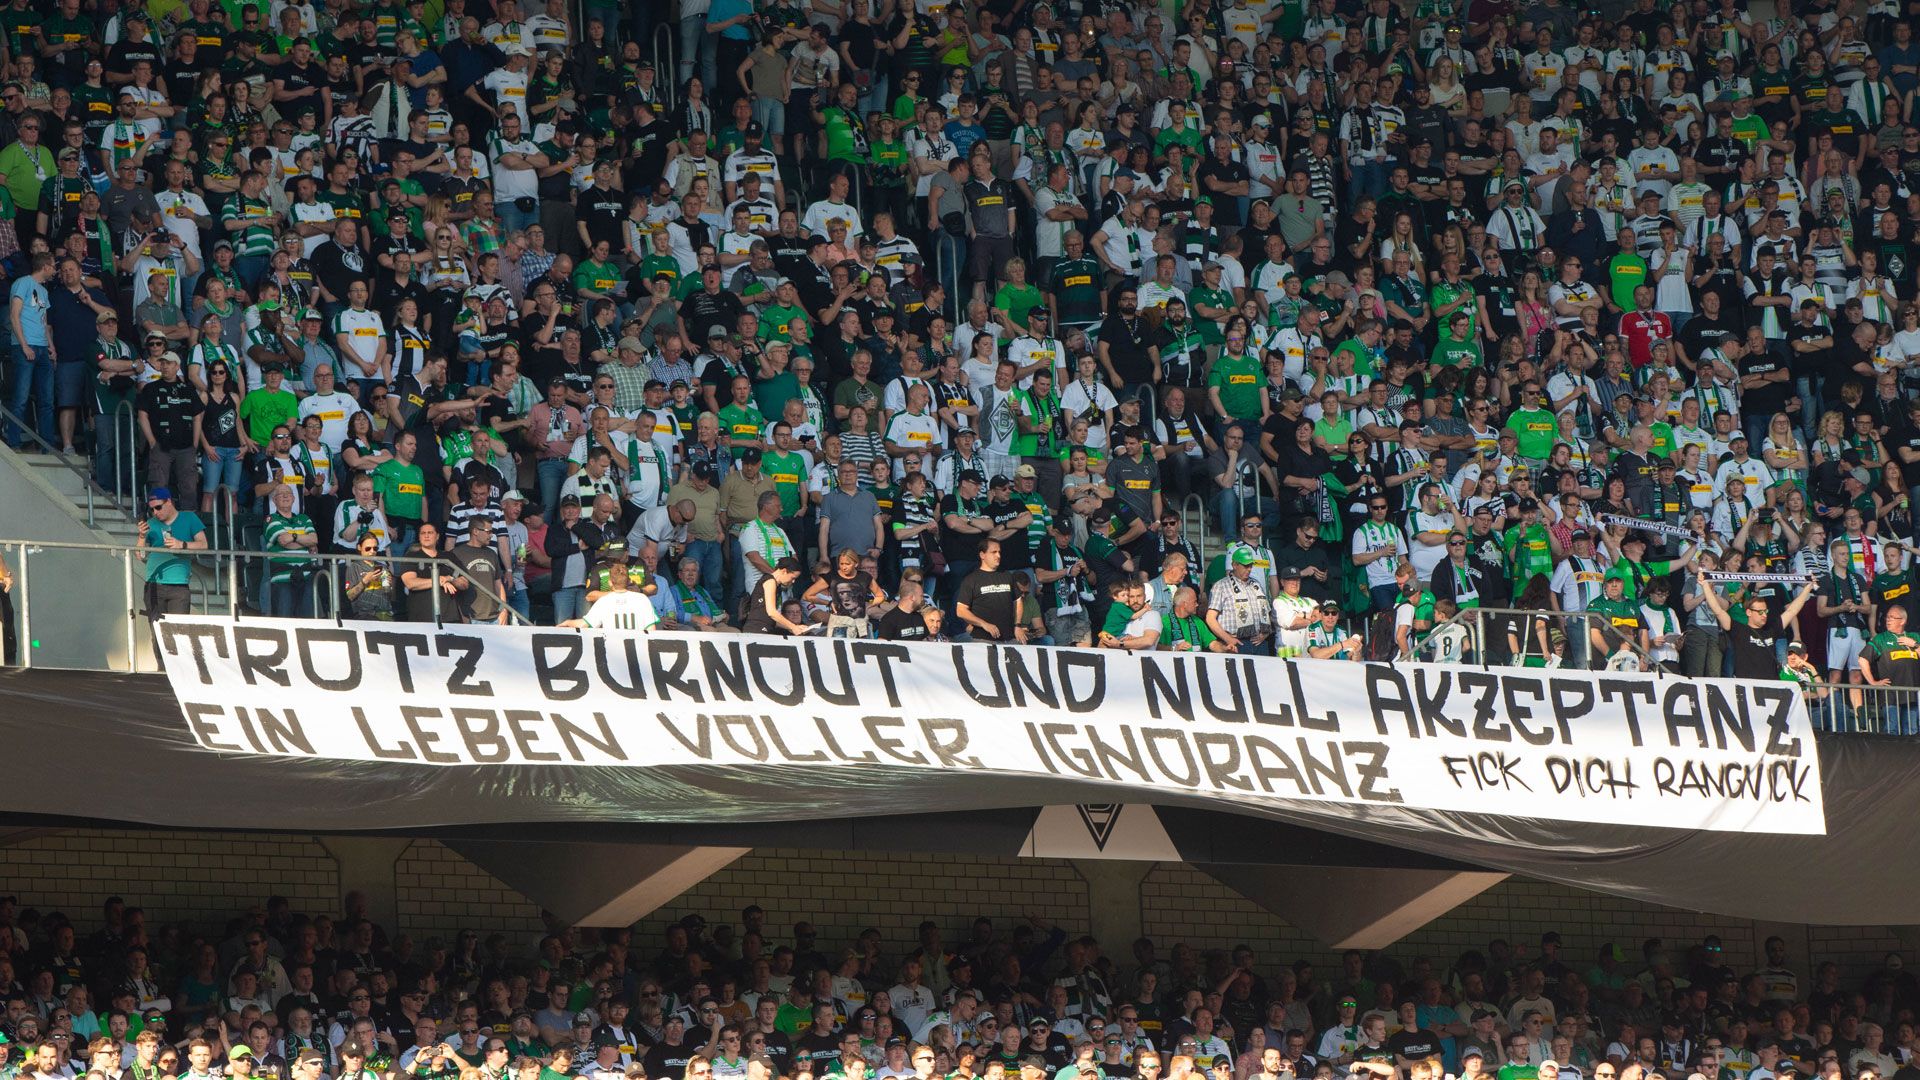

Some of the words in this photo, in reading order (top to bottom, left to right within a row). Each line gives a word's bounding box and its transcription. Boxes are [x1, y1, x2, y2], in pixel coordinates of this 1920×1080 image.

[1608, 515, 1692, 537] TRADITIONSVEREIN
[1710, 573, 1806, 581] TRADITIONSVEREIN
[1442, 636, 1453, 656] 8
[159, 622, 494, 696] TROTZ
[532, 633, 911, 708] BURNOUT
[951, 644, 1106, 713] UND
[1140, 651, 1340, 733] NULL
[1365, 663, 1801, 757] AKZEPTANZ
[184, 702, 317, 754] EIN
[351, 705, 628, 763] LEBEN
[656, 711, 985, 768] VOLLER
[1024, 722, 1404, 803] IGNORANZ
[1441, 751, 1533, 792] FICK
[1545, 756, 1640, 799] DICH
